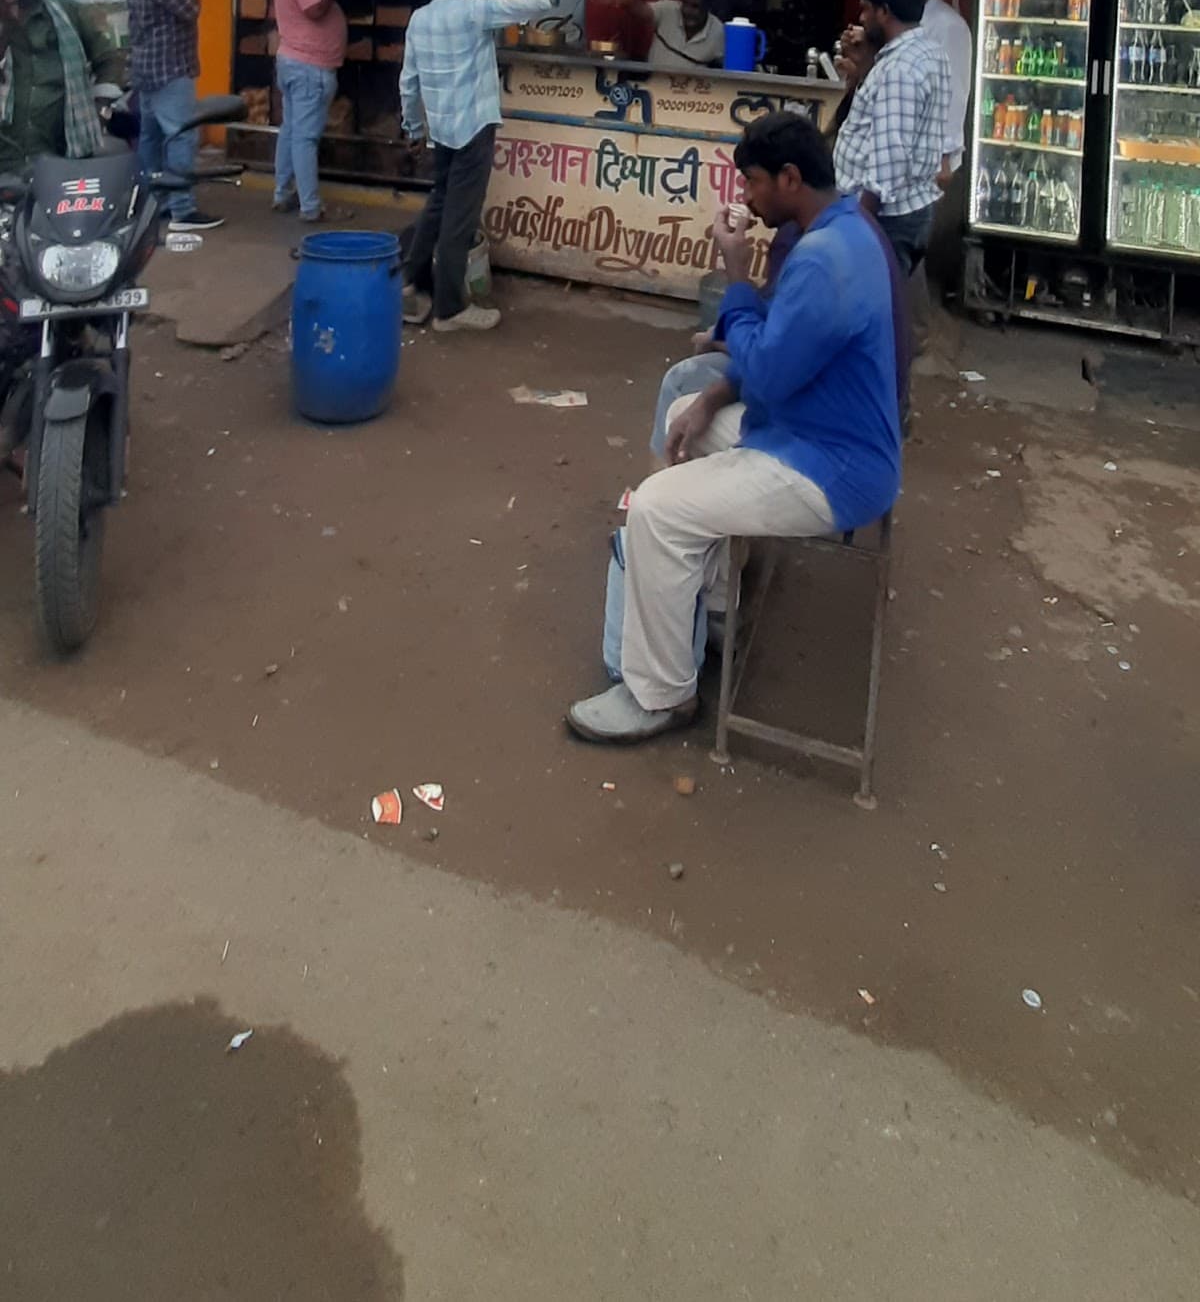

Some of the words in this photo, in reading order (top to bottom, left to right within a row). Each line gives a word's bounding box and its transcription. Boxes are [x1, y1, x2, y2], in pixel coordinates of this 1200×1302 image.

[519, 83, 584, 99] 9000192029
[656, 99, 724, 115] 9000192029
[492, 136, 592, 187] जस्थान
[484, 195, 590, 250] ajasthan
[588, 205, 670, 275] Divya
[658, 216, 708, 269] Tea
